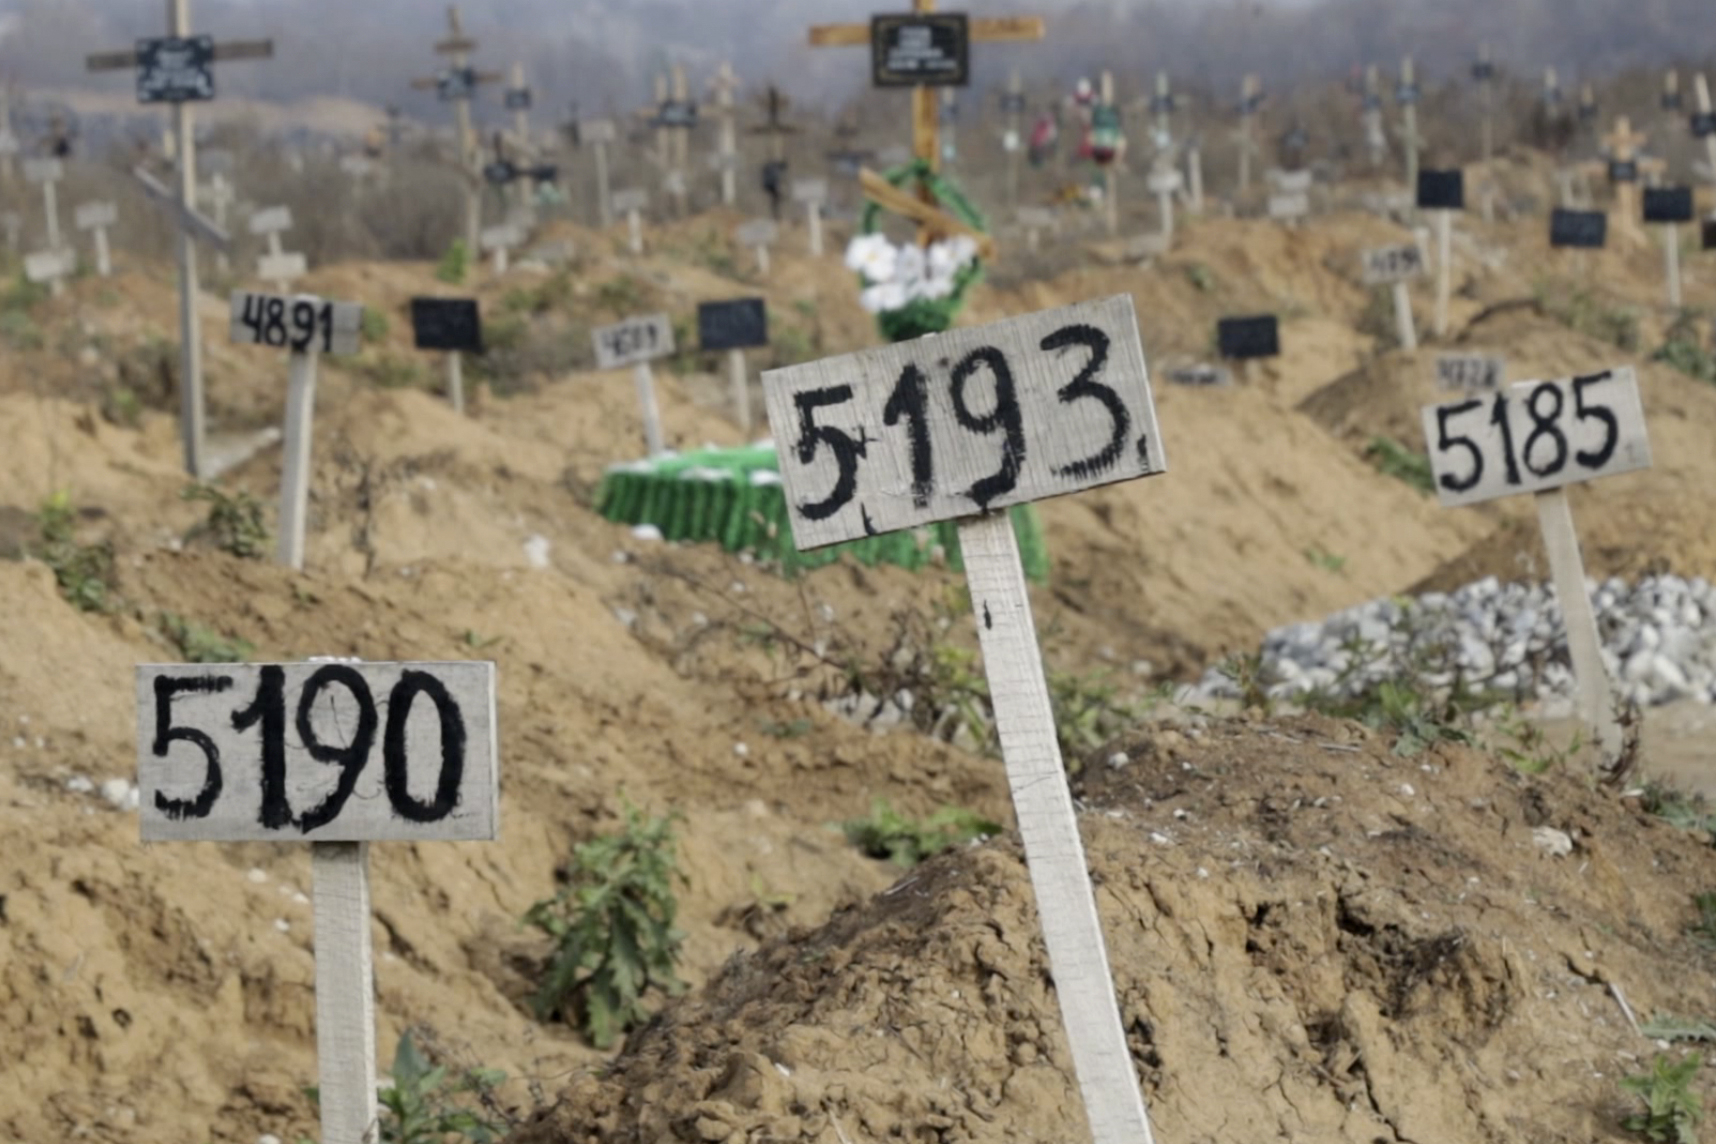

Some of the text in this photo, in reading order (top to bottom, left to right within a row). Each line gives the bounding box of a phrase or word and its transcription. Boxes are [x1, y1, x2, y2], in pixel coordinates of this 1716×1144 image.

[242, 294, 334, 353] 4891
[793, 324, 1131, 521] 5193
[1437, 370, 1618, 491] 5185
[153, 664, 466, 834] 5190
